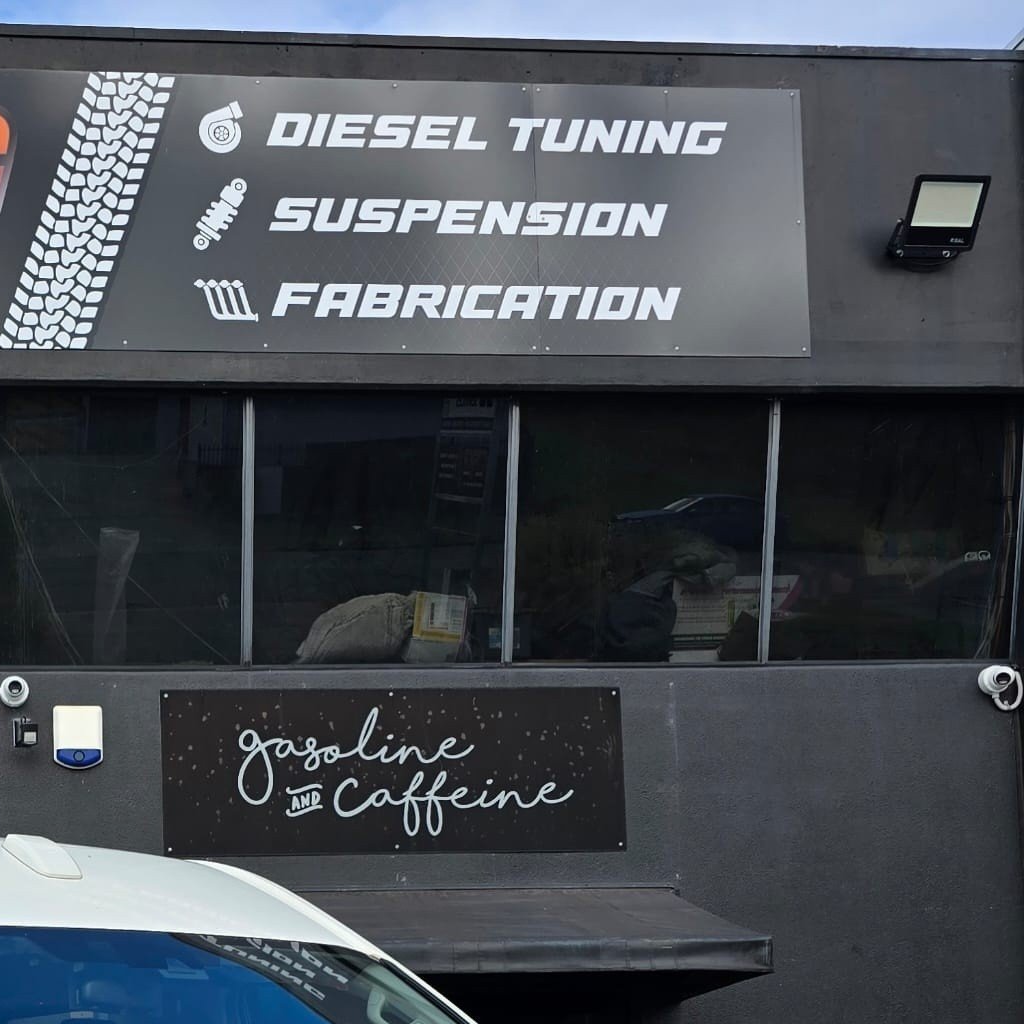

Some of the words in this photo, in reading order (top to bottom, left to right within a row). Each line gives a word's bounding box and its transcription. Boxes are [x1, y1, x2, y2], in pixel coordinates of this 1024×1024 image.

[266, 112, 488, 150] DIESEL
[508, 117, 728, 155] TUNING
[269, 197, 668, 237] SUSPENSION
[271, 282, 682, 321] FABRICATION
[237, 706, 475, 805] gasoline
[291, 792, 321, 811] AND
